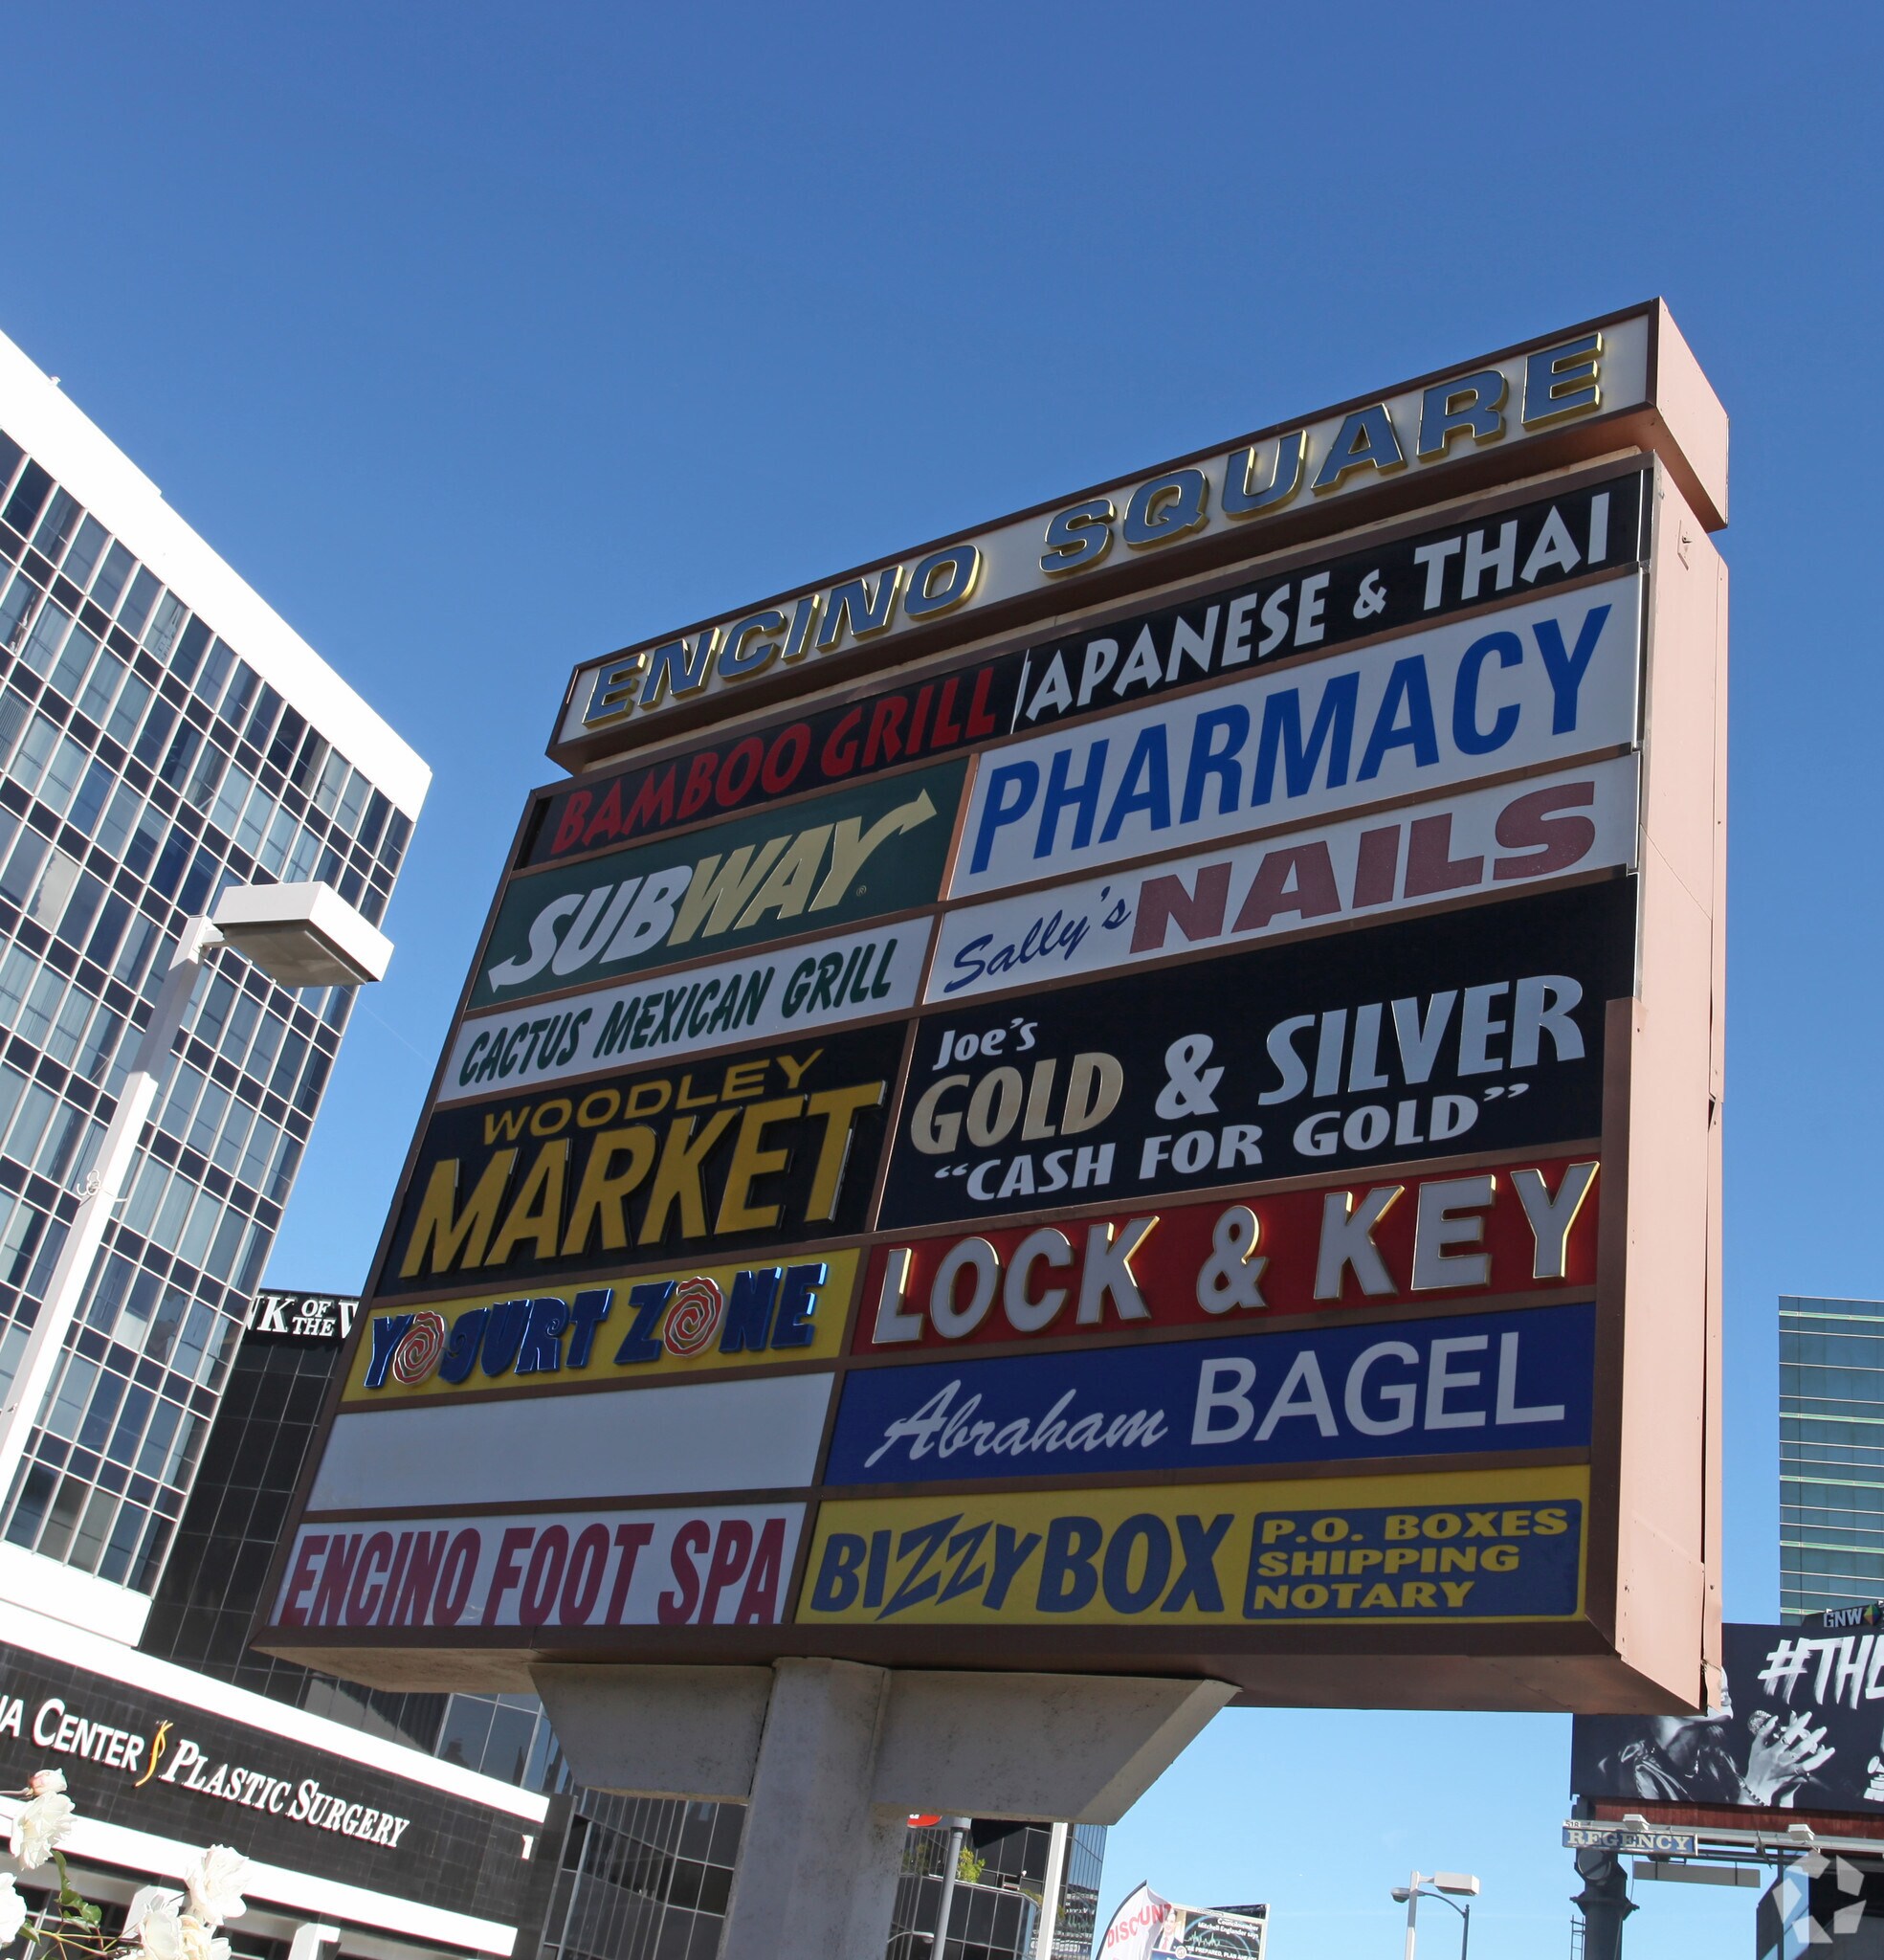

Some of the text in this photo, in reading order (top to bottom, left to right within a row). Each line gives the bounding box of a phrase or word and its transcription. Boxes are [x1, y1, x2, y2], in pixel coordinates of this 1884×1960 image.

[583, 332, 1604, 728] ENCINO SQUARE
[550, 492, 1611, 855] BAMBOO GRILL JAPANESE & THAI
[969, 603, 1613, 874] PHARMACY
[488, 788, 937, 993] SUBWAY
[943, 780, 1596, 993] Sally's NAILS
[458, 938, 898, 1086] CACTUS MEXICAN GRILL
[911, 974, 1585, 1154] GOLD & SILVER
[932, 1016, 1036, 1071] Joe's
[483, 1048, 824, 1145] WOODLEY
[398, 1080, 888, 1279] MARKET
[1139, 1124, 1263, 1180] FOR
[873, 1160, 1601, 1345] LOCK & KEY
[292, 1317, 336, 1336] THE
[301, 1300, 331, 1318] OF
[364, 1262, 828, 1388] YOGURT ZONE
[863, 1331, 1564, 1469] Abraham BAGEL
[278, 1518, 787, 1626] ENCINO FOOT SPA
[1256, 1546, 1519, 1578] SHIPPING
[1260, 1508, 1569, 1545] P.O. BOXES
[1253, 1582, 1475, 1610] NOTARY
[1824, 1608, 1862, 1628] GNW
[33, 1698, 145, 1771] CENTER
[159, 1739, 410, 1847] PLASTIC SURGERY
[1568, 1829, 1690, 1851] REGENCY
[1107, 1903, 1172, 1948] DISCOUNT
